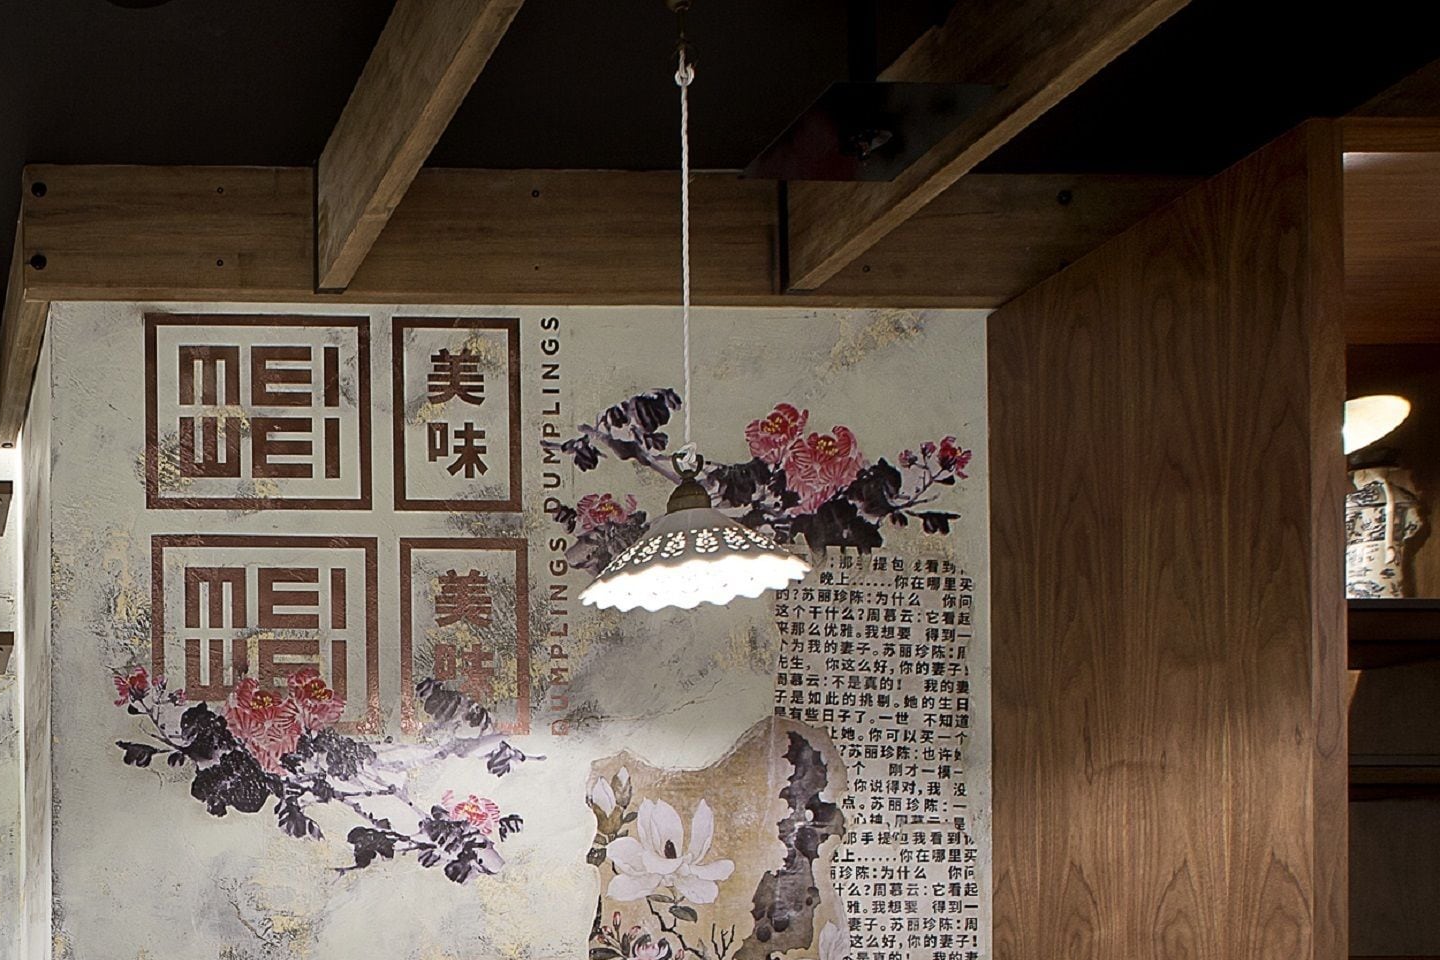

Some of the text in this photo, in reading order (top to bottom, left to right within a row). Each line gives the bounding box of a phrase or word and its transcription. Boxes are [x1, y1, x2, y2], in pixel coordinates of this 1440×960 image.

[178, 416, 341, 479] WEI
[426, 347, 489, 480] 美味
[540, 316, 561, 514] DUMPLINGS
[548, 536, 570, 737] DUMPLINGS
